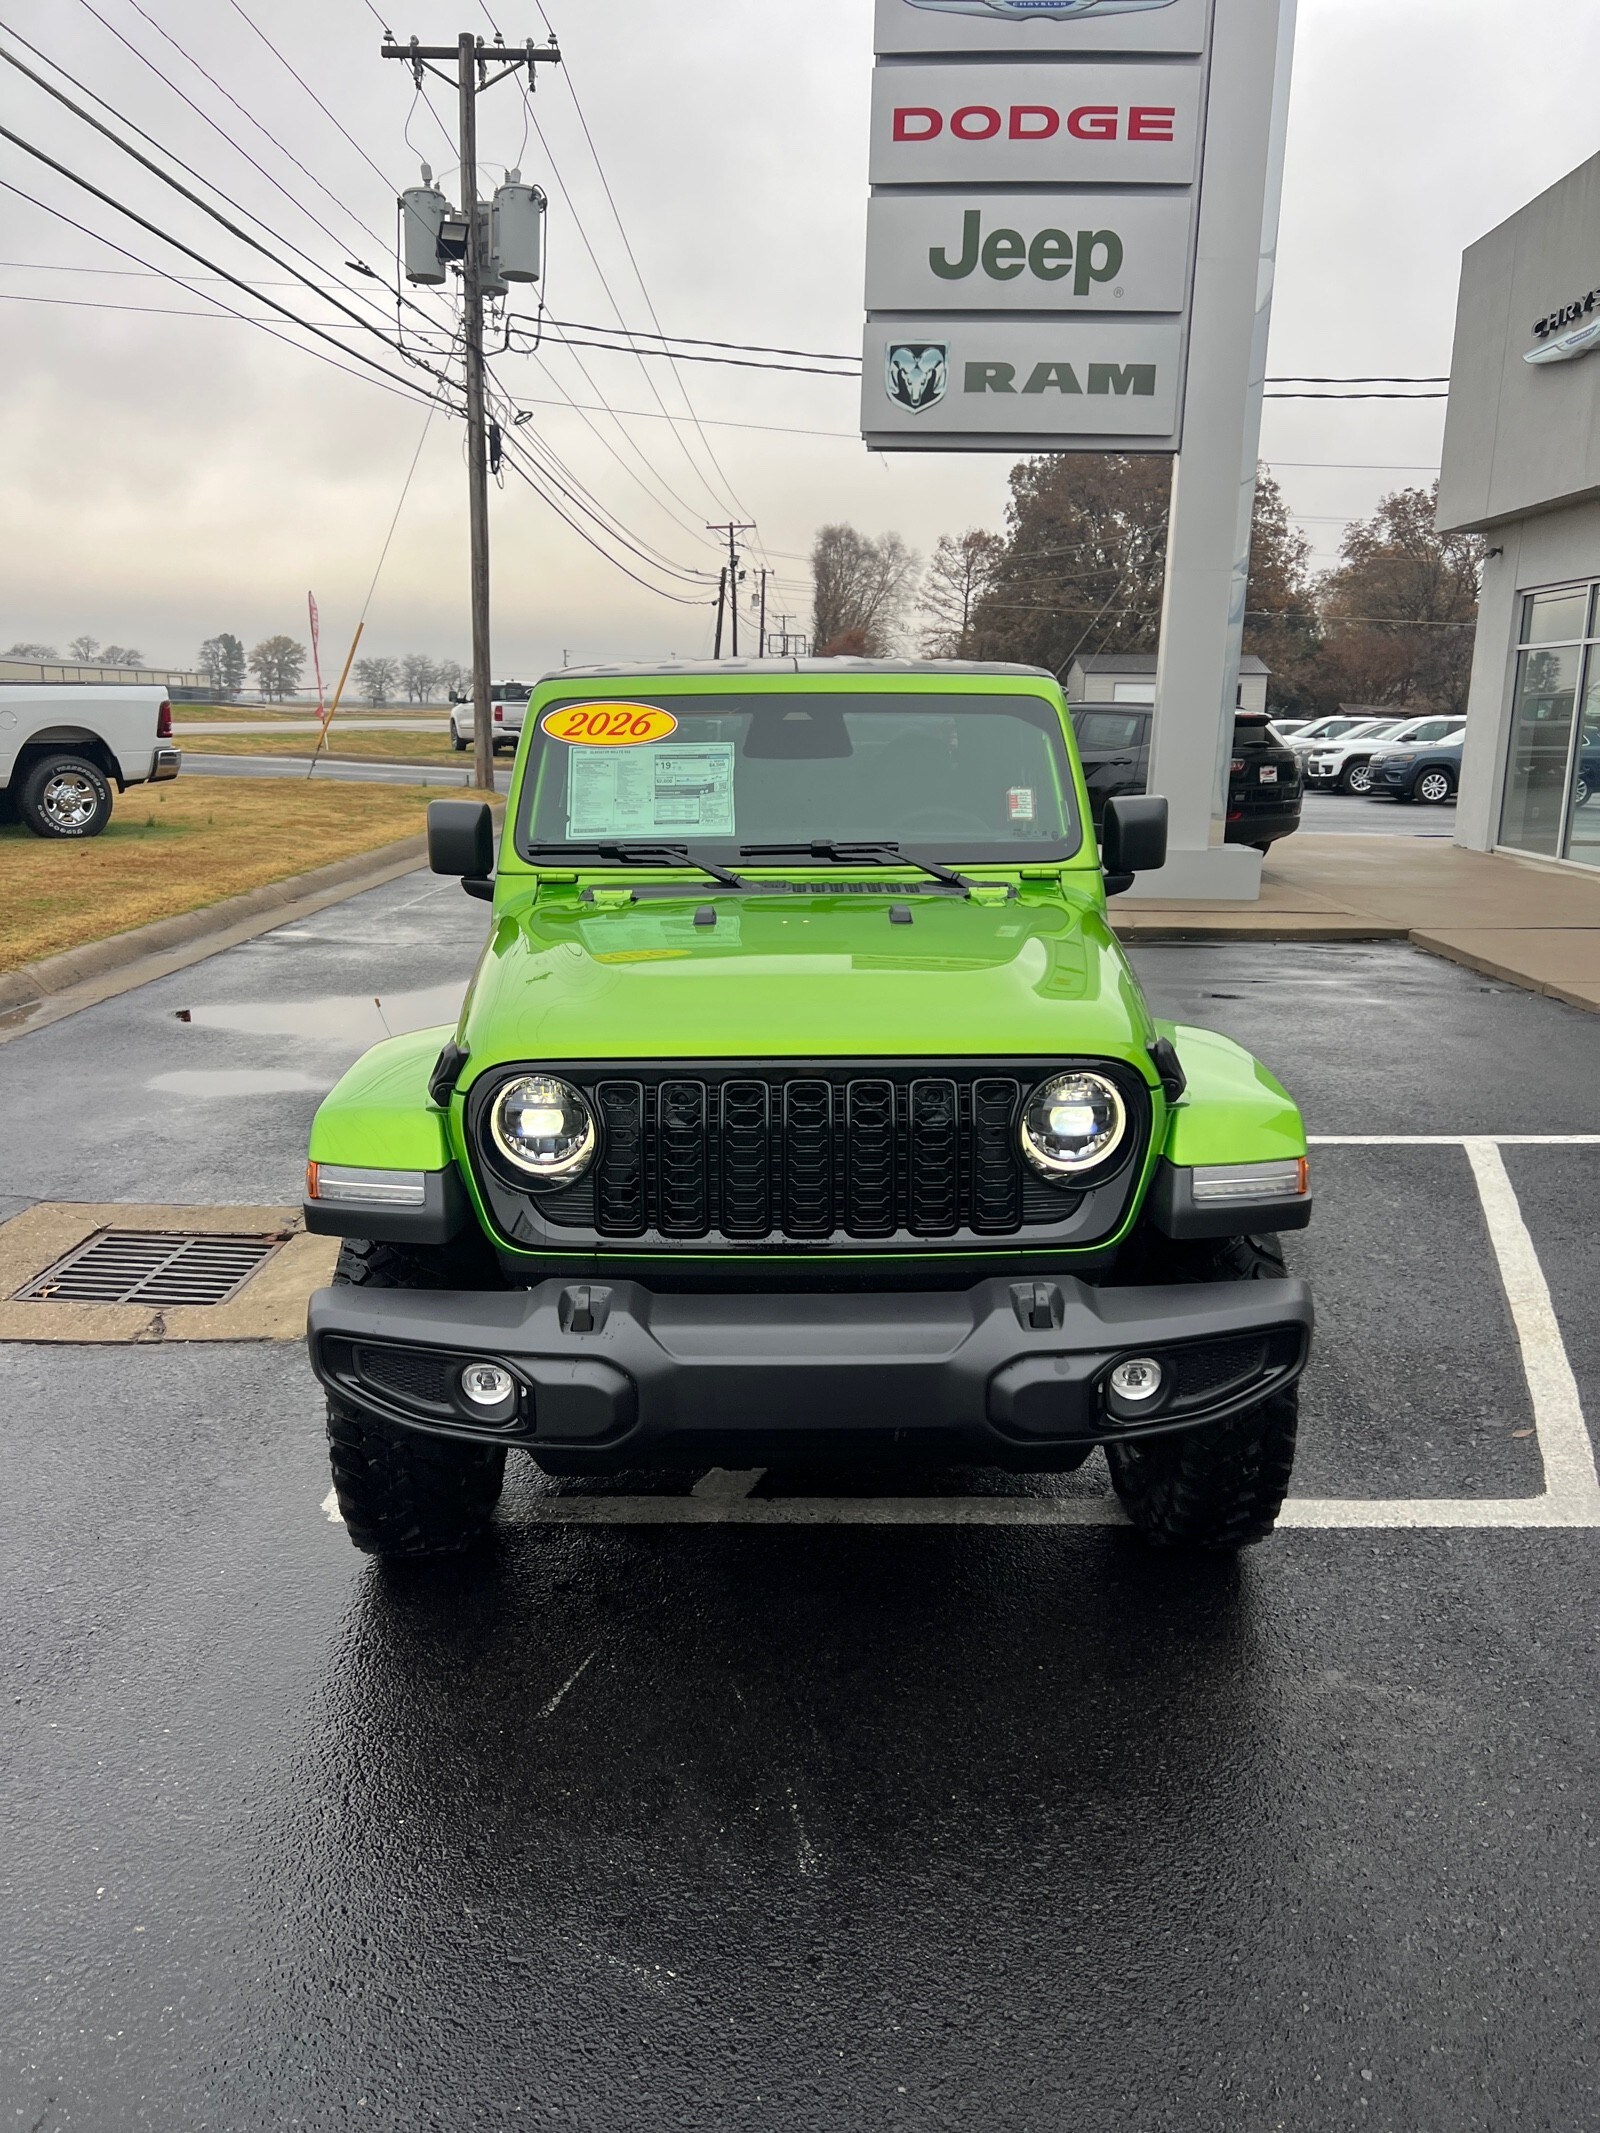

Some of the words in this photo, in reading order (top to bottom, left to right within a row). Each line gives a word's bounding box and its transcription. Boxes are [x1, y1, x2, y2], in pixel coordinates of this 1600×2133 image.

[892, 105, 1176, 142] DODGE
[928, 209, 1124, 296] Jeep
[963, 361, 1157, 396] RAM
[562, 712, 657, 737] 2026
[660, 761, 672, 770] 19
